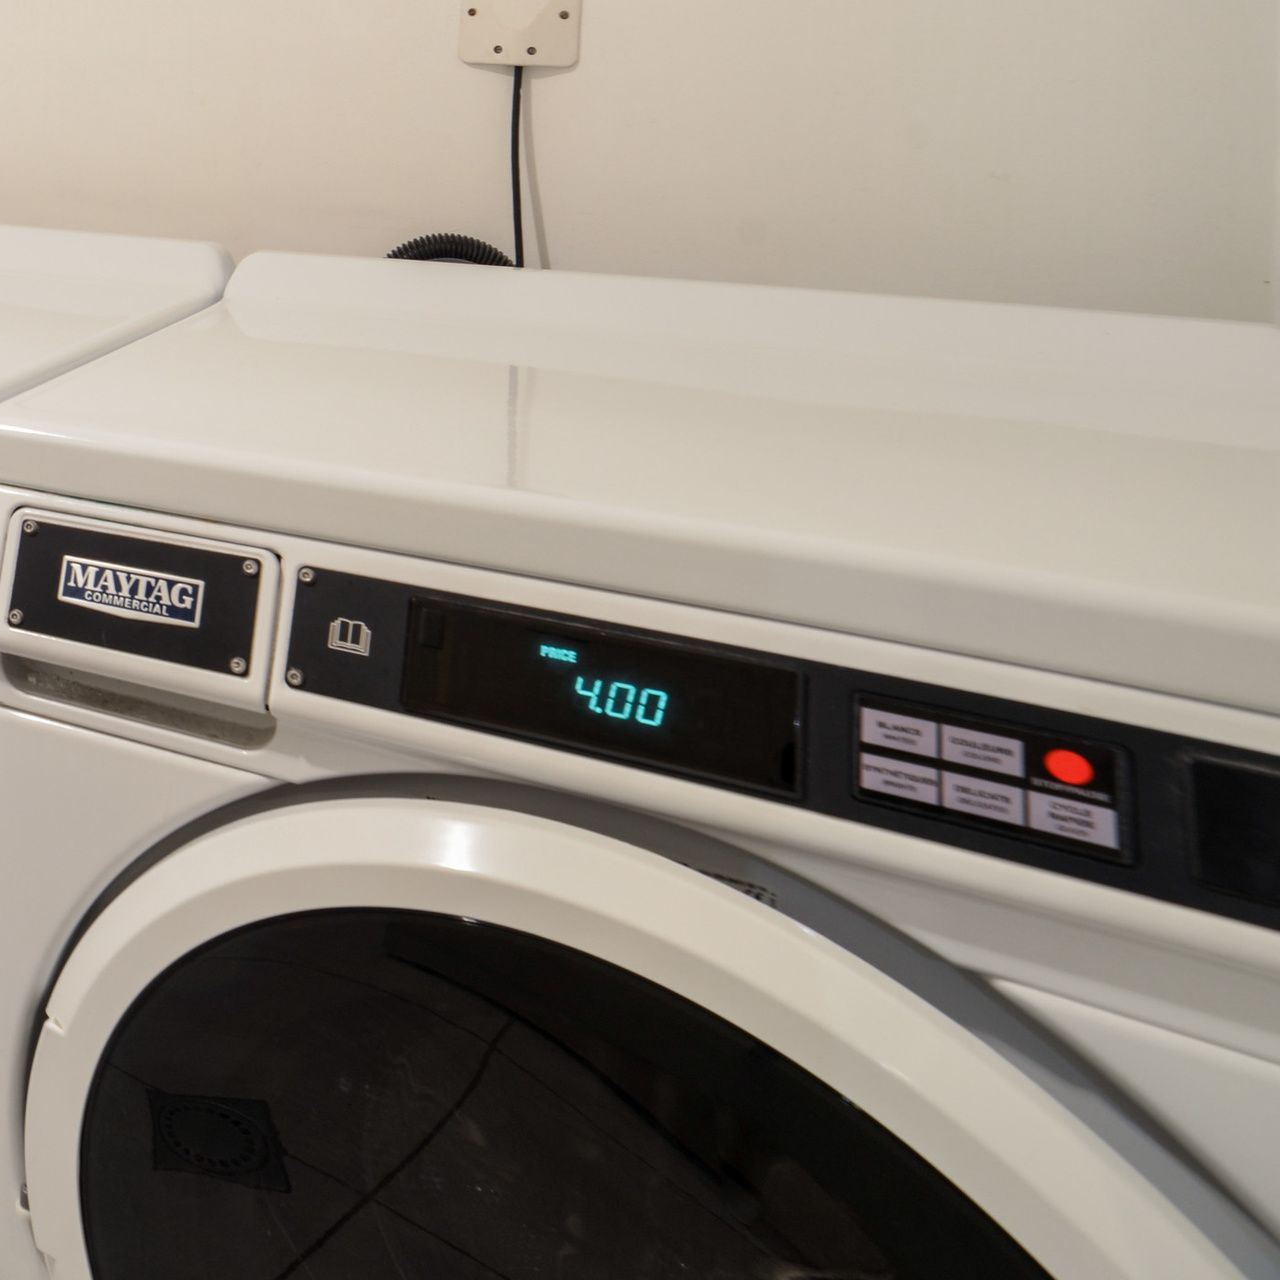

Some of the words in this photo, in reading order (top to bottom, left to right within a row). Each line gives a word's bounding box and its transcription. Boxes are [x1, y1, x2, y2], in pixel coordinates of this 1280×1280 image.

[67, 562, 194, 610] MAYTAG
[84, 590, 170, 616] COMMERCIAL
[540, 644, 577, 663] PRICE
[575, 676, 668, 727] 4.00
